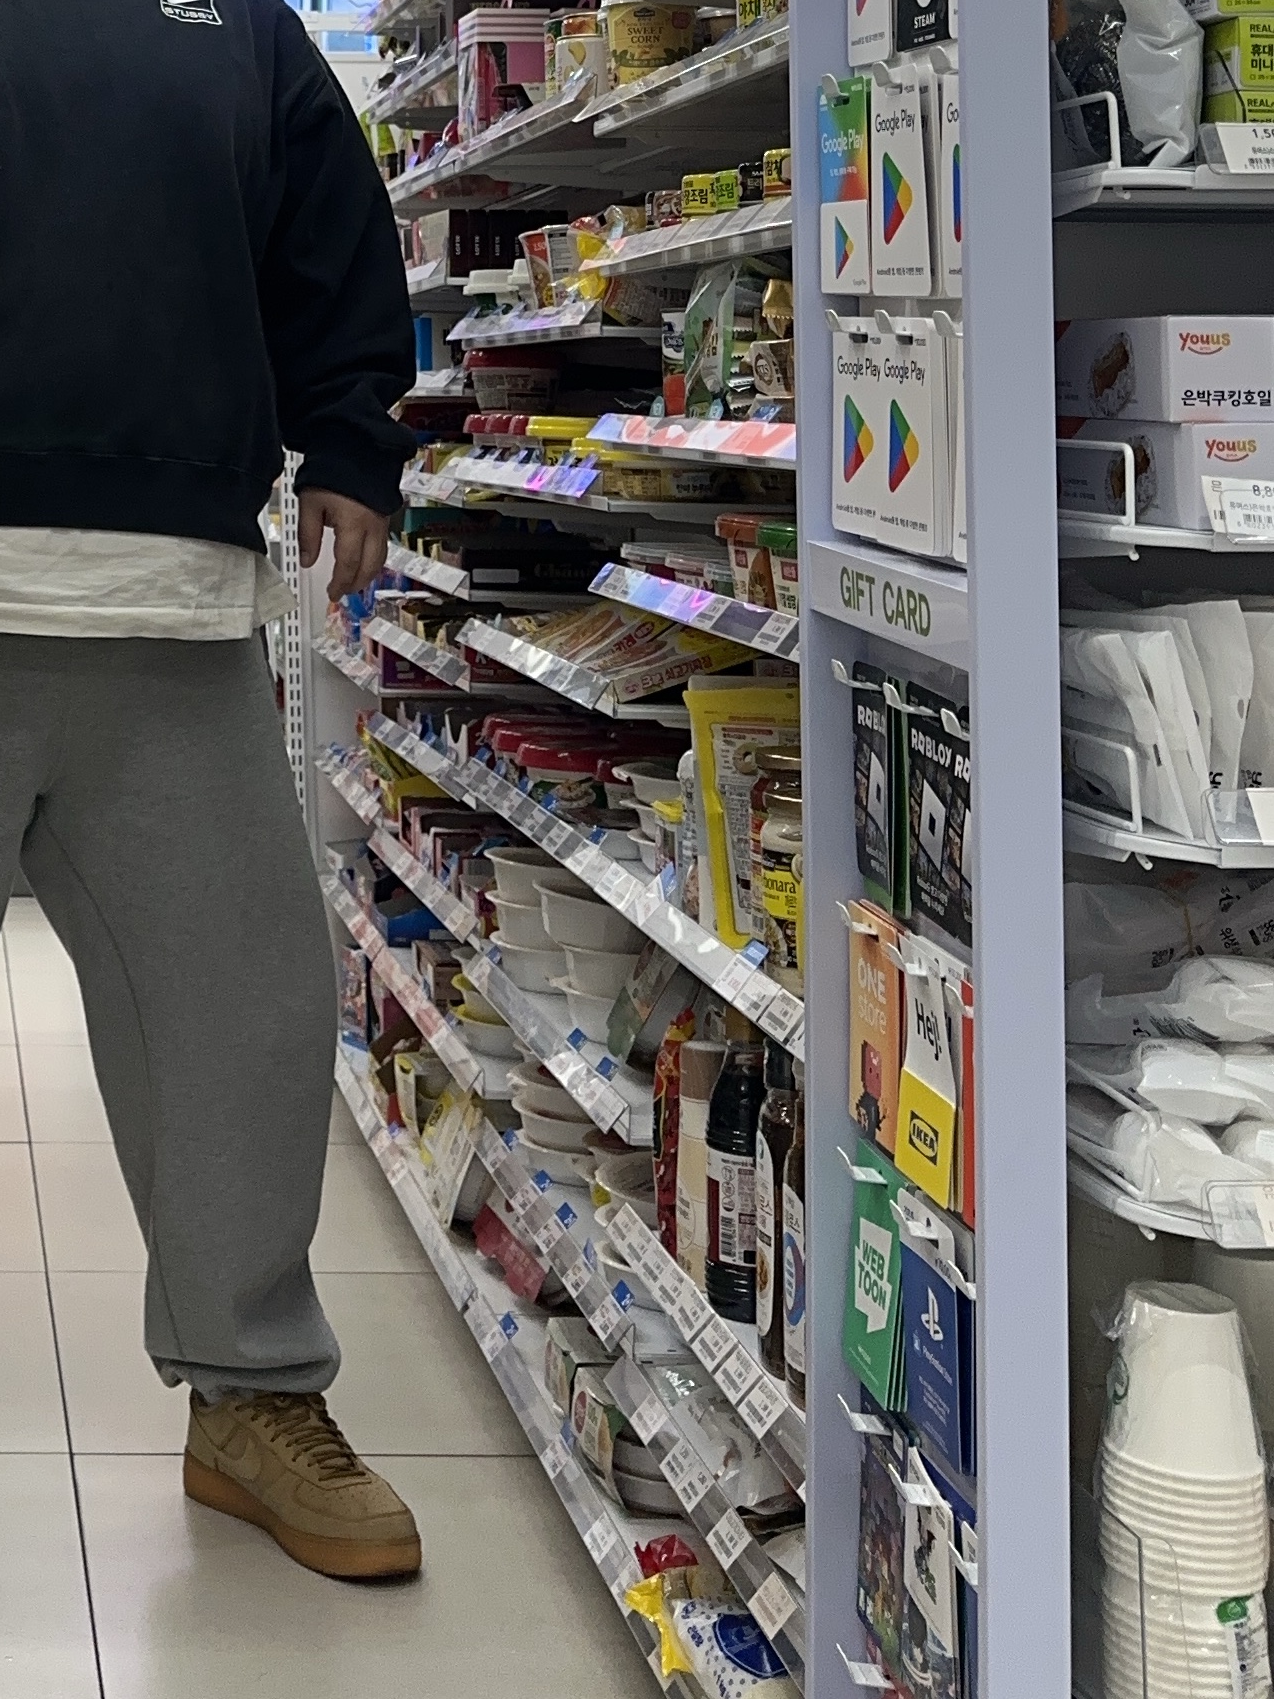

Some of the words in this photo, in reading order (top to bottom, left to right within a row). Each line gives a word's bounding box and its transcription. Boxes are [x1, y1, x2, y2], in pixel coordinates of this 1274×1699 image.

[626, 26, 664, 36] SWEET
[913, 13, 937, 30] STEAM
[630, 34, 661, 44] CORN
[1250, 43, 1274, 58] 휴대
[1250, 57, 1274, 72] 미니
[874, 110, 901, 137] Google
[901, 108, 916, 133] Play
[820, 132, 848, 157] Google
[847, 128, 864, 153] Play
[1179, 332, 1232, 352] youus
[837, 354, 865, 380] Google
[865, 357, 881, 381] Play
[883, 356, 910, 386] Google
[910, 359, 926, 387] Play
[1181, 389, 1272, 407] 은박쿠킹호일
[1205, 439, 1258, 460] youus
[839, 565, 876, 617] GIFT
[882, 579, 933, 638] CARD
[910, 727, 952, 768] ROBLOX
[858, 958, 887, 1007] ONE
[858, 1000, 888, 1036] store
[915, 996, 942, 1061] Hej!
[910, 1117, 938, 1159] IKEA
[861, 1239, 886, 1280] WEB
[857, 1269, 887, 1312] TOON
